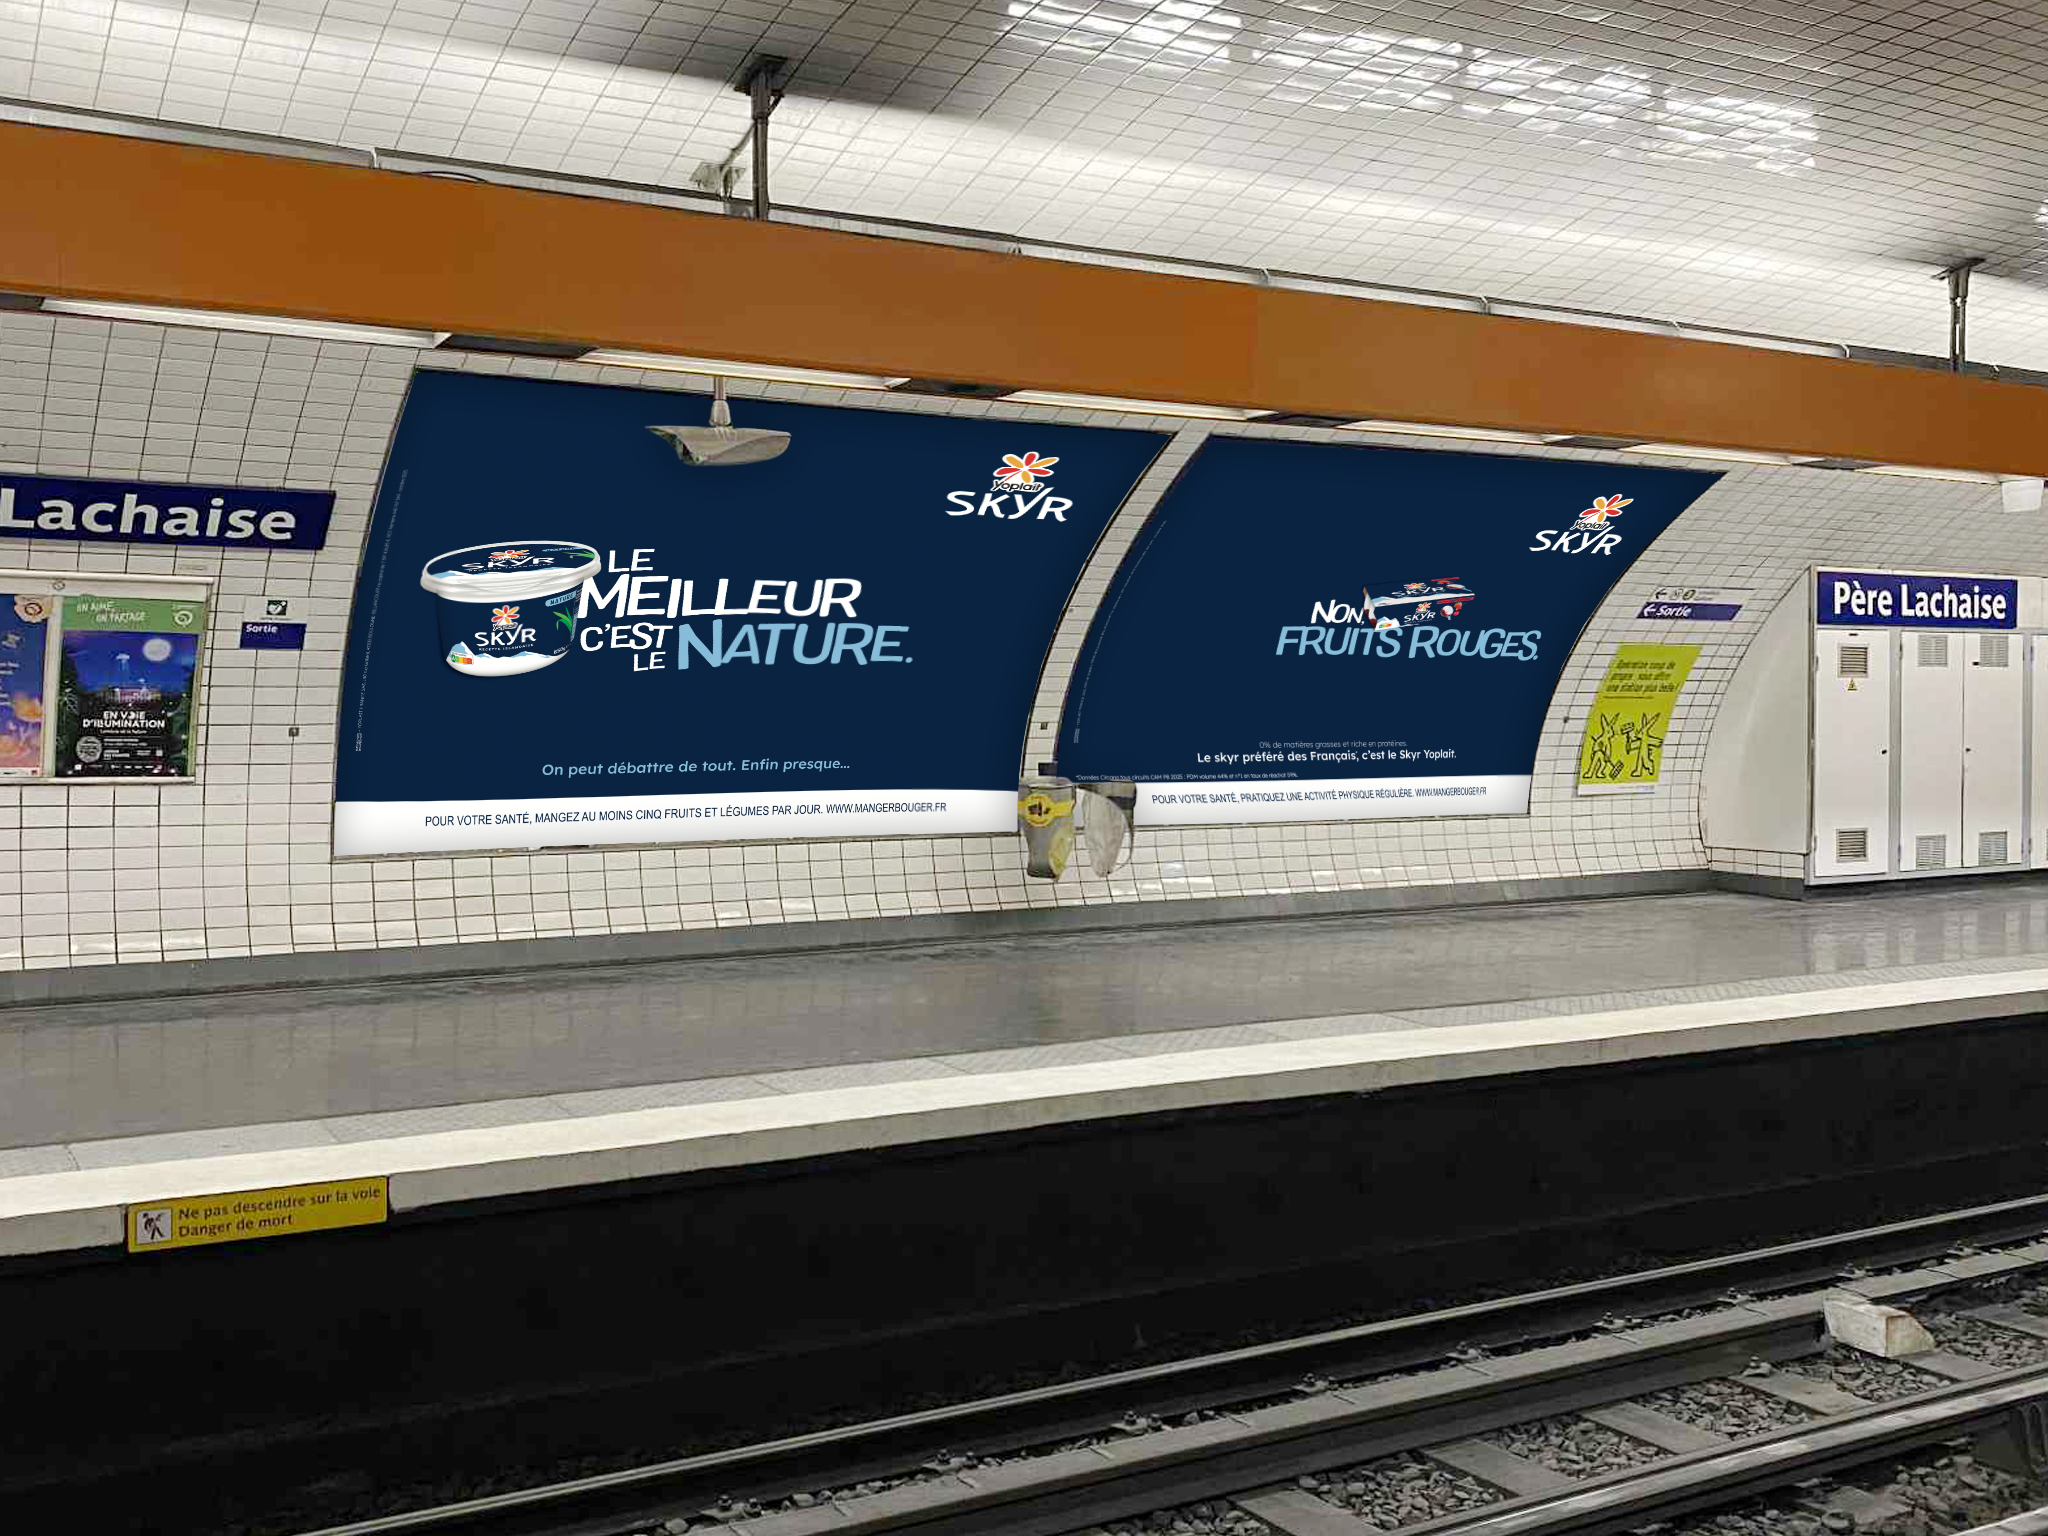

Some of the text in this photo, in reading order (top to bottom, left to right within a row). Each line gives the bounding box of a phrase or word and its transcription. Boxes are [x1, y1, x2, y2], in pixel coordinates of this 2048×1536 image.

[991, 480, 1043, 492] Yoplait
[0, 488, 297, 541] Lachaise
[945, 486, 1073, 522] SKYR
[1570, 520, 1611, 532] Yoplait
[1528, 525, 1622, 556] SKYR
[462, 556, 554, 570] SKYR
[608, 548, 655, 573] LE
[577, 573, 862, 619] MEILLEUR
[1833, 580, 2007, 620] Père Lachaise
[1311, 599, 1364, 625] NON,
[1403, 610, 1436, 622] SKYR
[1656, 605, 1692, 617] Sortie
[246, 624, 278, 633] Sortie
[474, 623, 537, 647] SKYR
[677, 618, 914, 671] NATURE.
[1275, 625, 1542, 662] FRUITS ROUGES.
[634, 651, 666, 671] LE
[103, 711, 118, 720] EN
[1259, 741, 1271, 749] 0%
[1273, 741, 1281, 750] de
[1283, 740, 1313, 749] matières
[1315, 741, 1341, 750] grasses
[1343, 740, 1349, 748] et
[1351, 739, 1367, 748] riche
[1378, 740, 1408, 749] protéines.
[542, 758, 849, 778] On peut débattre de tout. Enfin presque...
[1198, 753, 1211, 762] Le
[1215, 752, 1239, 765] skyr
[1243, 751, 1284, 764] préféré
[1288, 751, 1307, 761] des
[1388, 750, 1396, 759] le
[1400, 750, 1421, 761] Skyr
[1424, 749, 1456, 760] Yoplait.
[1152, 787, 1486, 804] POUR VOTRE SANTÉ, PRATIQUEZ UNE ACTIVITÉ PHYSIQUE RÉGULIÈRE. WWW.MANGERBOUGER.FR
[426, 803, 946, 826] POUR VOTRE SANTÉ, MANGEZ AU MOINS CINQ FRUITS ET LÉGUMES PAR JOUR. WWW.MANGERBOUGER.FR
[178, 1208, 199, 1220] Ne
[204, 1206, 227, 1220] pas
[233, 1196, 305, 1216] descendre
[310, 1193, 330, 1206] sur
[335, 1189, 349, 1203] la
[178, 1212, 293, 1238] Danger de mort
